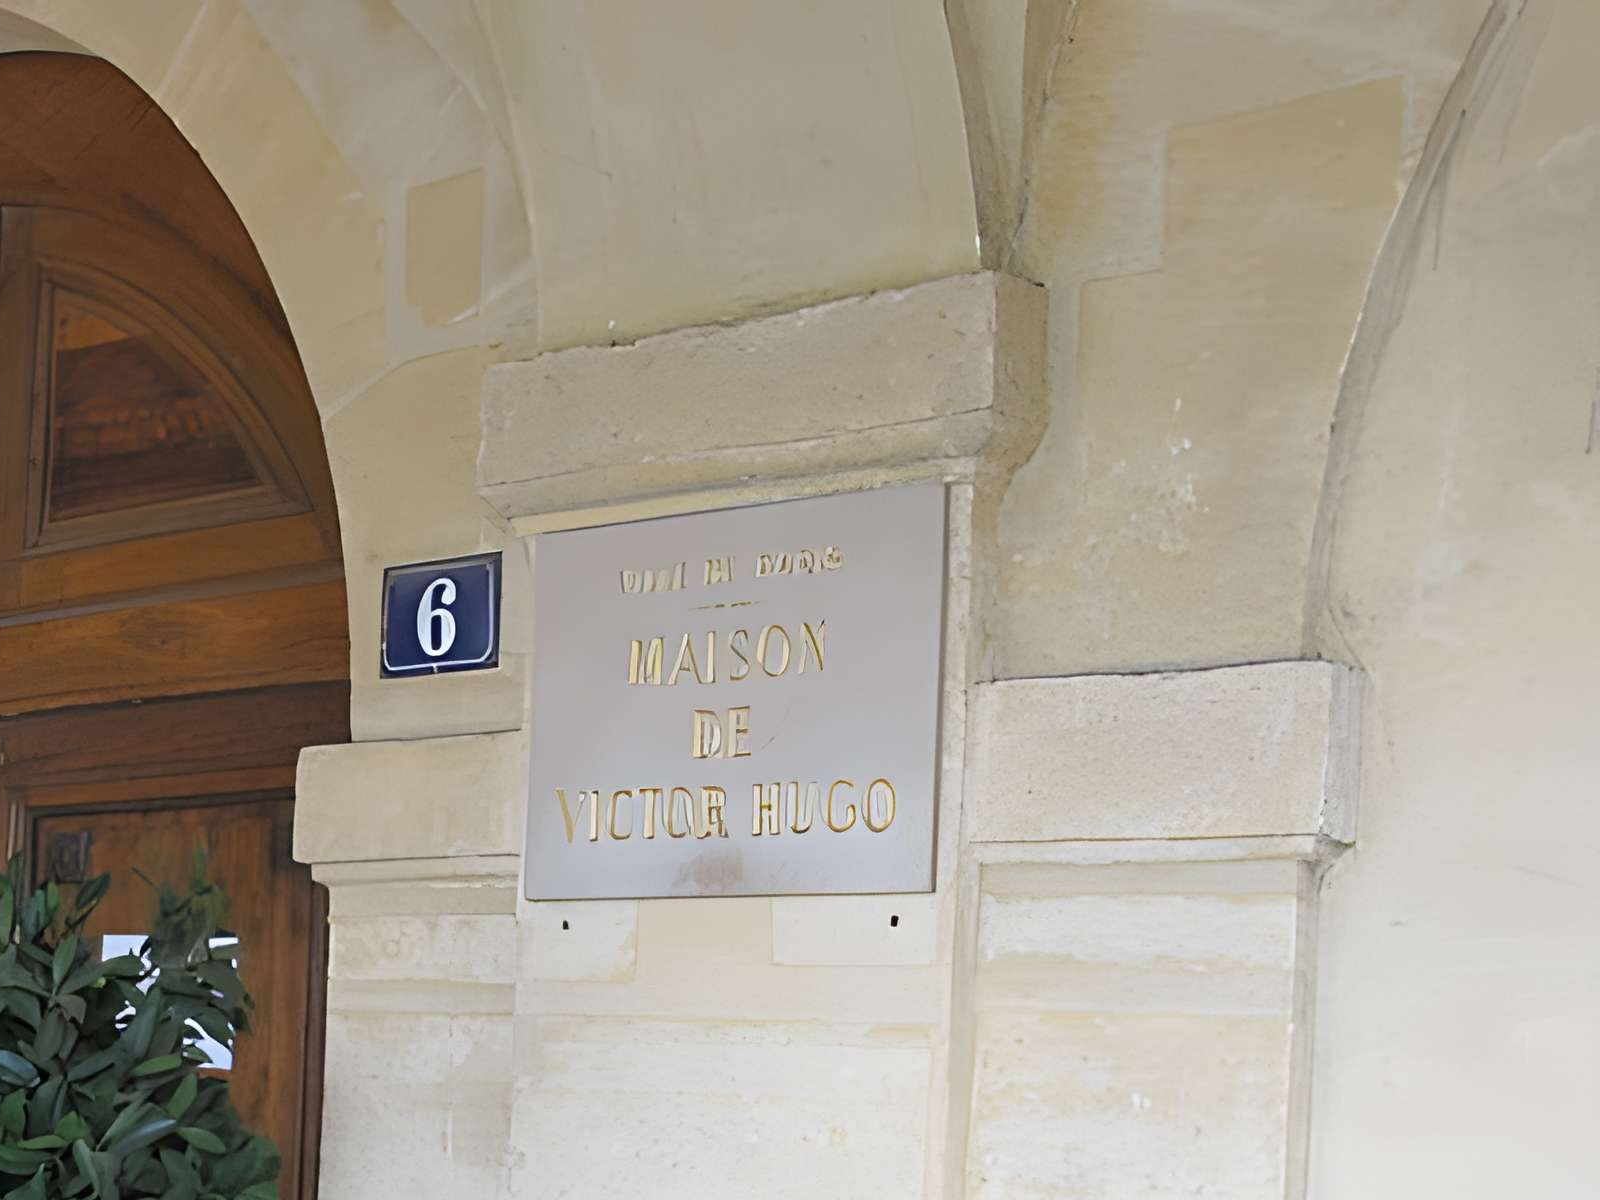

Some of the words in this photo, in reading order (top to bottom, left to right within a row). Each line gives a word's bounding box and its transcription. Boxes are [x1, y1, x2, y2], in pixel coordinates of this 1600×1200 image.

[417, 577, 456, 656] 6
[628, 620, 826, 686] MAISON
[692, 706, 752, 759] DE
[555, 785, 728, 842] VICTOR
[751, 778, 897, 836] HUGO
